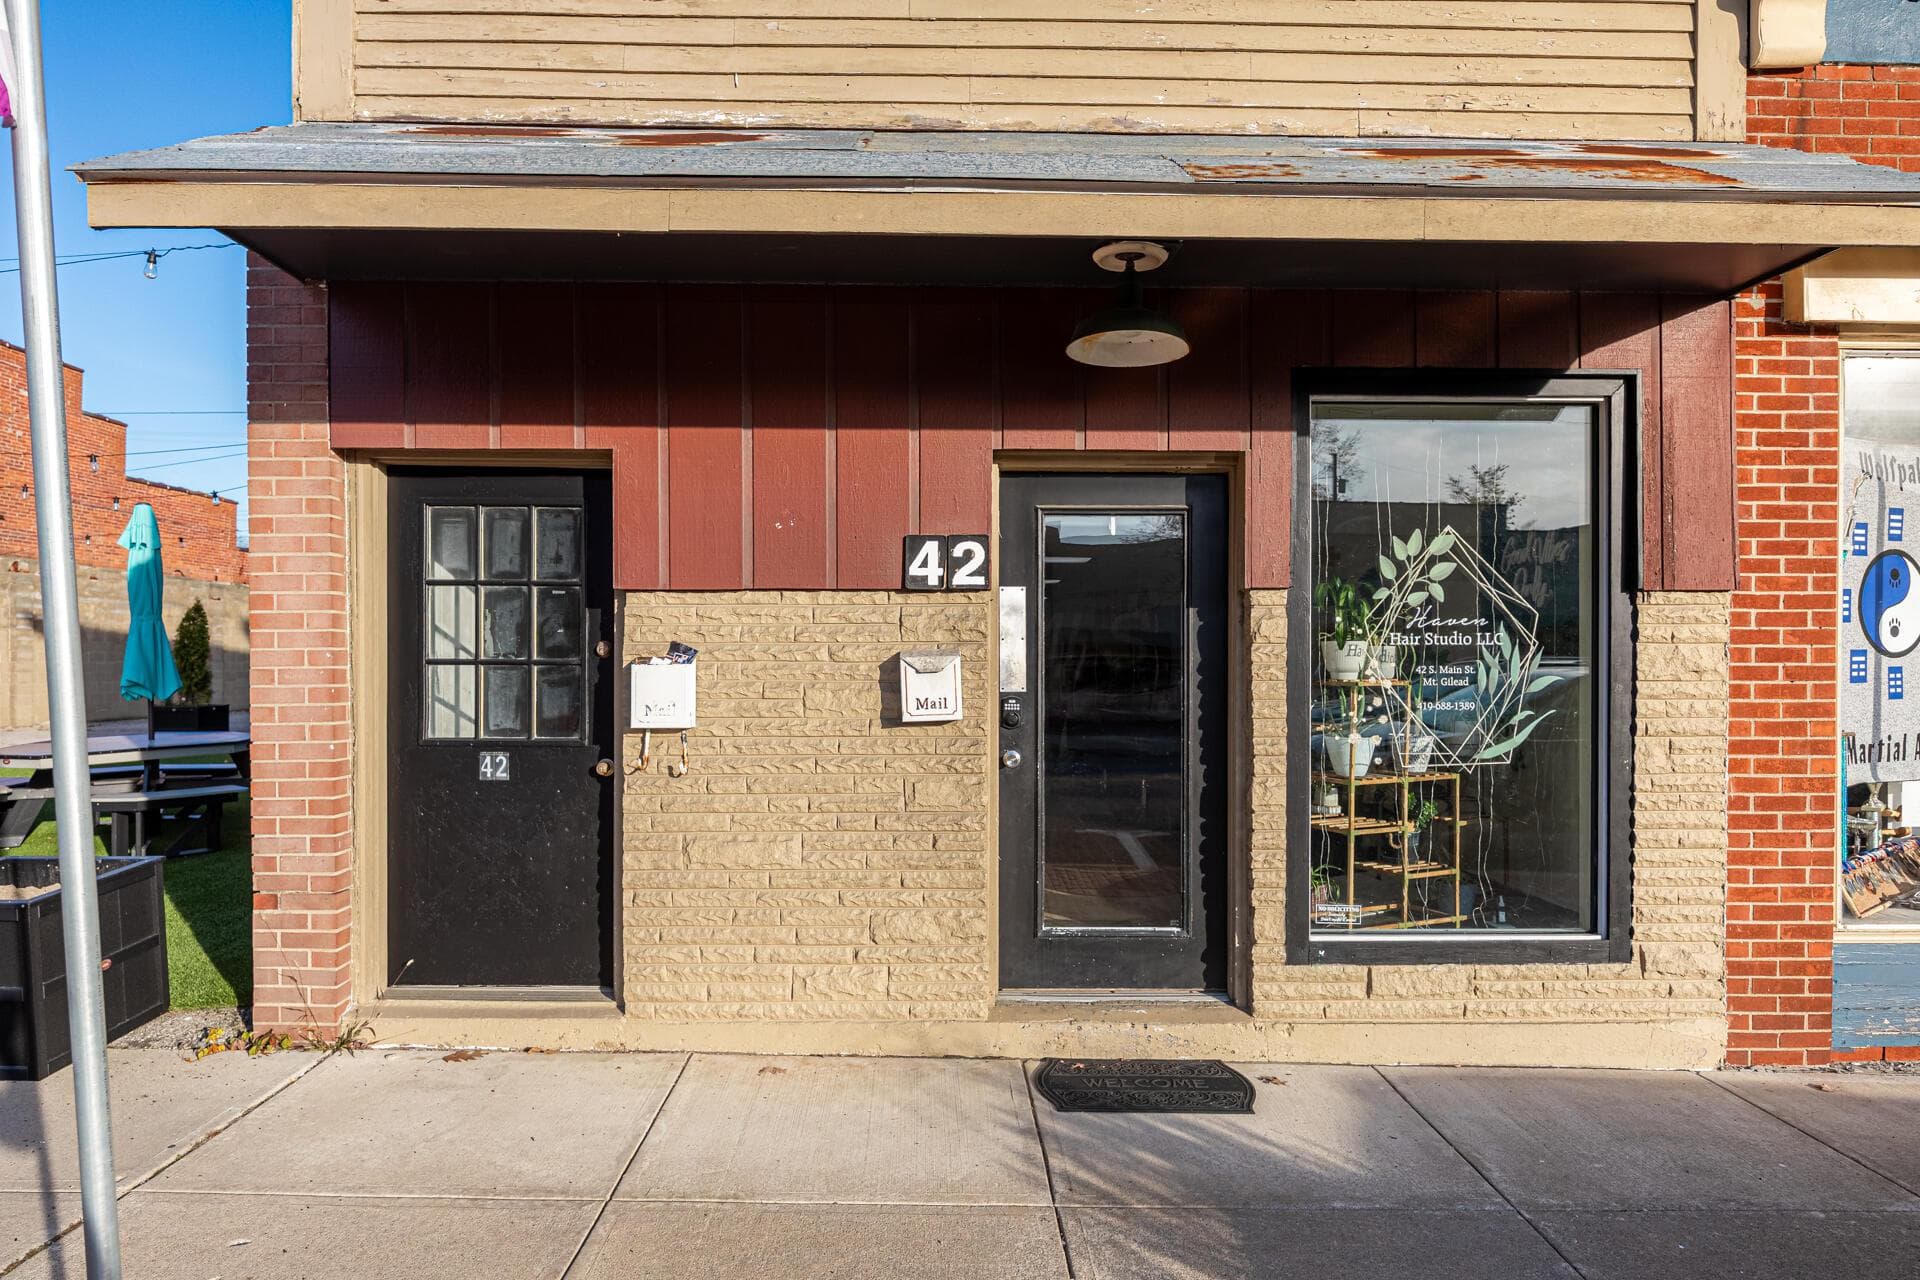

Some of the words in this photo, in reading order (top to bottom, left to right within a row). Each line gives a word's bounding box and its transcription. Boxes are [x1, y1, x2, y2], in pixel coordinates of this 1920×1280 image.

[908, 540, 986, 586] 42
[1406, 605, 1488, 629] Haven
[1390, 633, 1421, 646] Hair
[1425, 631, 1472, 646] Studio
[1476, 633, 1504, 646] LLC
[1416, 666, 1426, 674] 42
[1428, 666, 1437, 674] S.
[1440, 665, 1463, 674] Main
[1465, 666, 1476, 674] St.
[1423, 678, 1438, 686] Mt.
[1441, 677, 1469, 686] Gilead
[916, 697, 948, 711] Mail
[1417, 702, 1476, 711] 419-688-1389
[1847, 733, 1907, 765] Martial
[481, 755, 507, 777] 42
[1082, 1077, 1209, 1089] WELCOME
